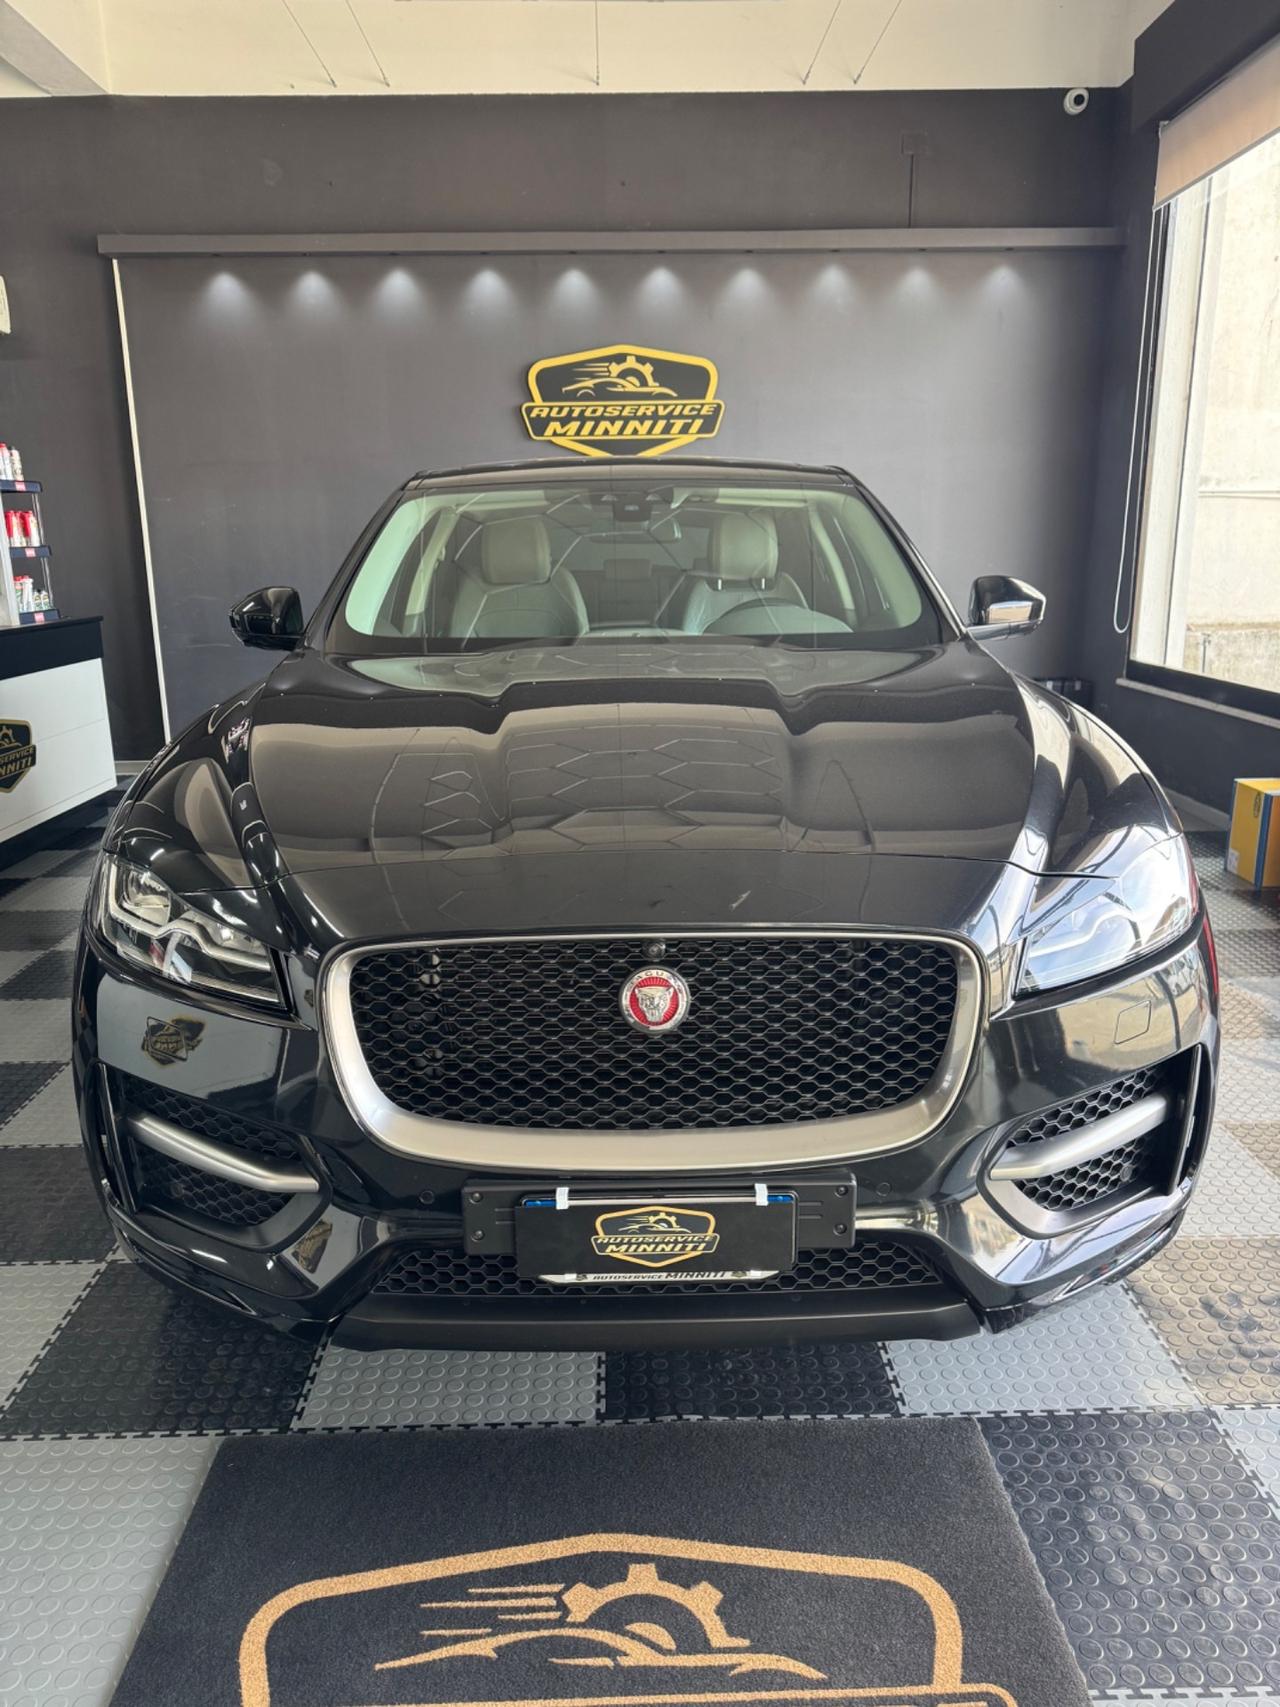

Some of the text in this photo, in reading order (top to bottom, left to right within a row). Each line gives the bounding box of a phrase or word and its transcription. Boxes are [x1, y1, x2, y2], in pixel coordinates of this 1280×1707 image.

[530, 404, 717, 418] AUTOSERVICE
[544, 419, 704, 436] MINNITI
[597, 1235, 714, 1244] AUTOSERVICE
[604, 1243, 706, 1253] MINNITI
[665, 1271, 726, 1279] MINNITI
